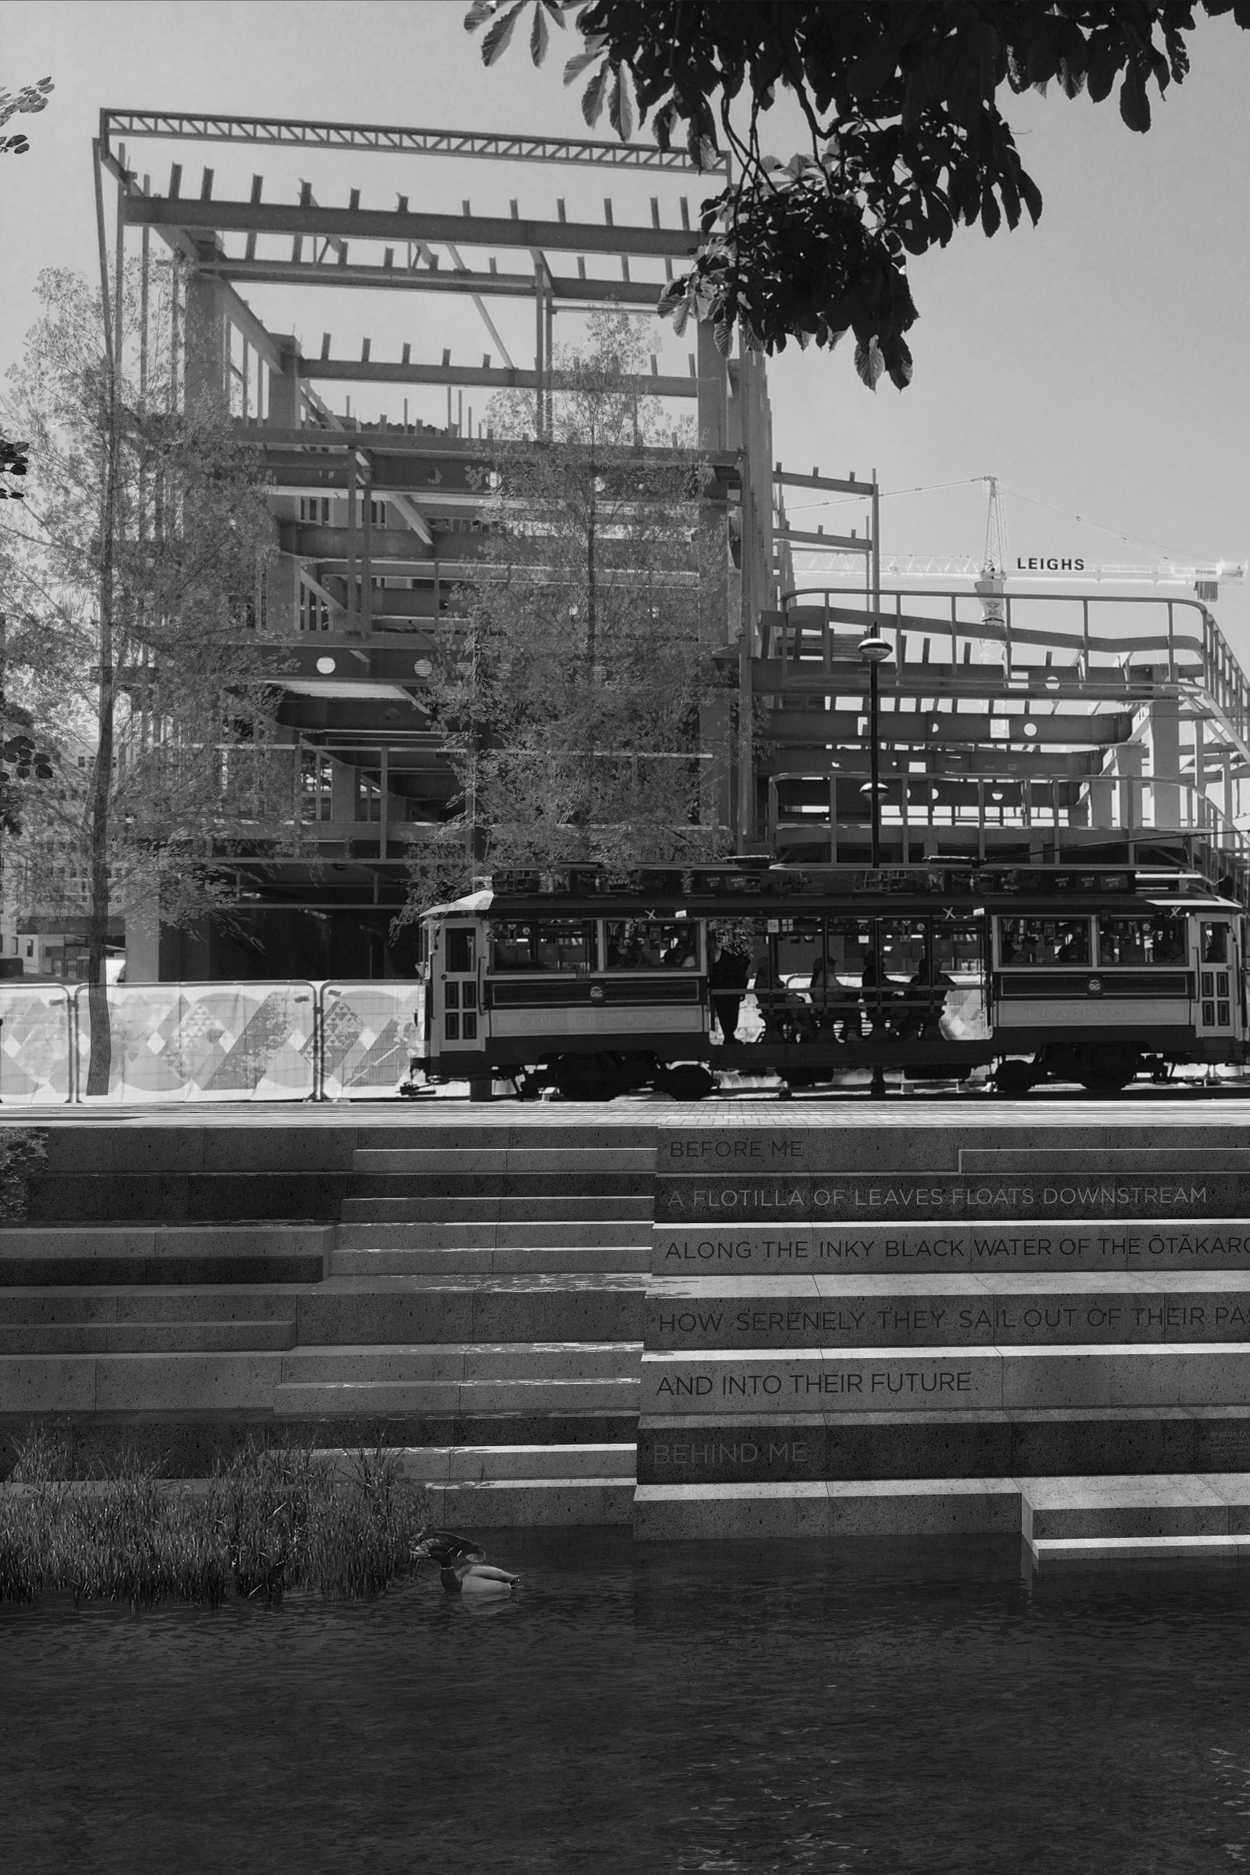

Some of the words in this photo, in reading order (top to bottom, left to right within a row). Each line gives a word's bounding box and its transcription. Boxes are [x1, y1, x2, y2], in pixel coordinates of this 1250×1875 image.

[1017, 557, 1085, 571] LEIGHS
[669, 1141, 760, 1158] BEFORE
[771, 1141, 803, 1157] ME
[668, 1191, 686, 1207] A
[693, 1190, 805, 1207] FLOTILLA
[813, 1189, 850, 1206] OF
[855, 1188, 943, 1206] LEAVES
[952, 1188, 1034, 1205] FLOATS
[1043, 1187, 1207, 1205] DOWNSTREAM
[664, 1241, 752, 1260] ALONG
[763, 1241, 808, 1258] THE
[819, 1240, 875, 1258] INKY
[885, 1239, 964, 1257] BLACK
[974, 1238, 1051, 1256] WATER
[1058, 1238, 1092, 1255] OF
[1097, 1237, 1141, 1255] THE
[659, 1313, 724, 1332] HOW
[736, 1311, 866, 1331] SERENELY
[877, 1310, 945, 1329] THEY
[959, 1309, 1016, 1329] SAIL
[1023, 1308, 1077, 1327] OUT
[1087, 1308, 1122, 1327] OF
[1133, 1307, 1205, 1326] THEIR
[656, 1376, 713, 1396] AND
[722, 1376, 782, 1395] INTO
[790, 1374, 862, 1393] THEIR
[871, 1372, 971, 1392] FUTURE
[653, 1444, 759, 1464] BEHIND
[769, 1443, 809, 1463] ME
